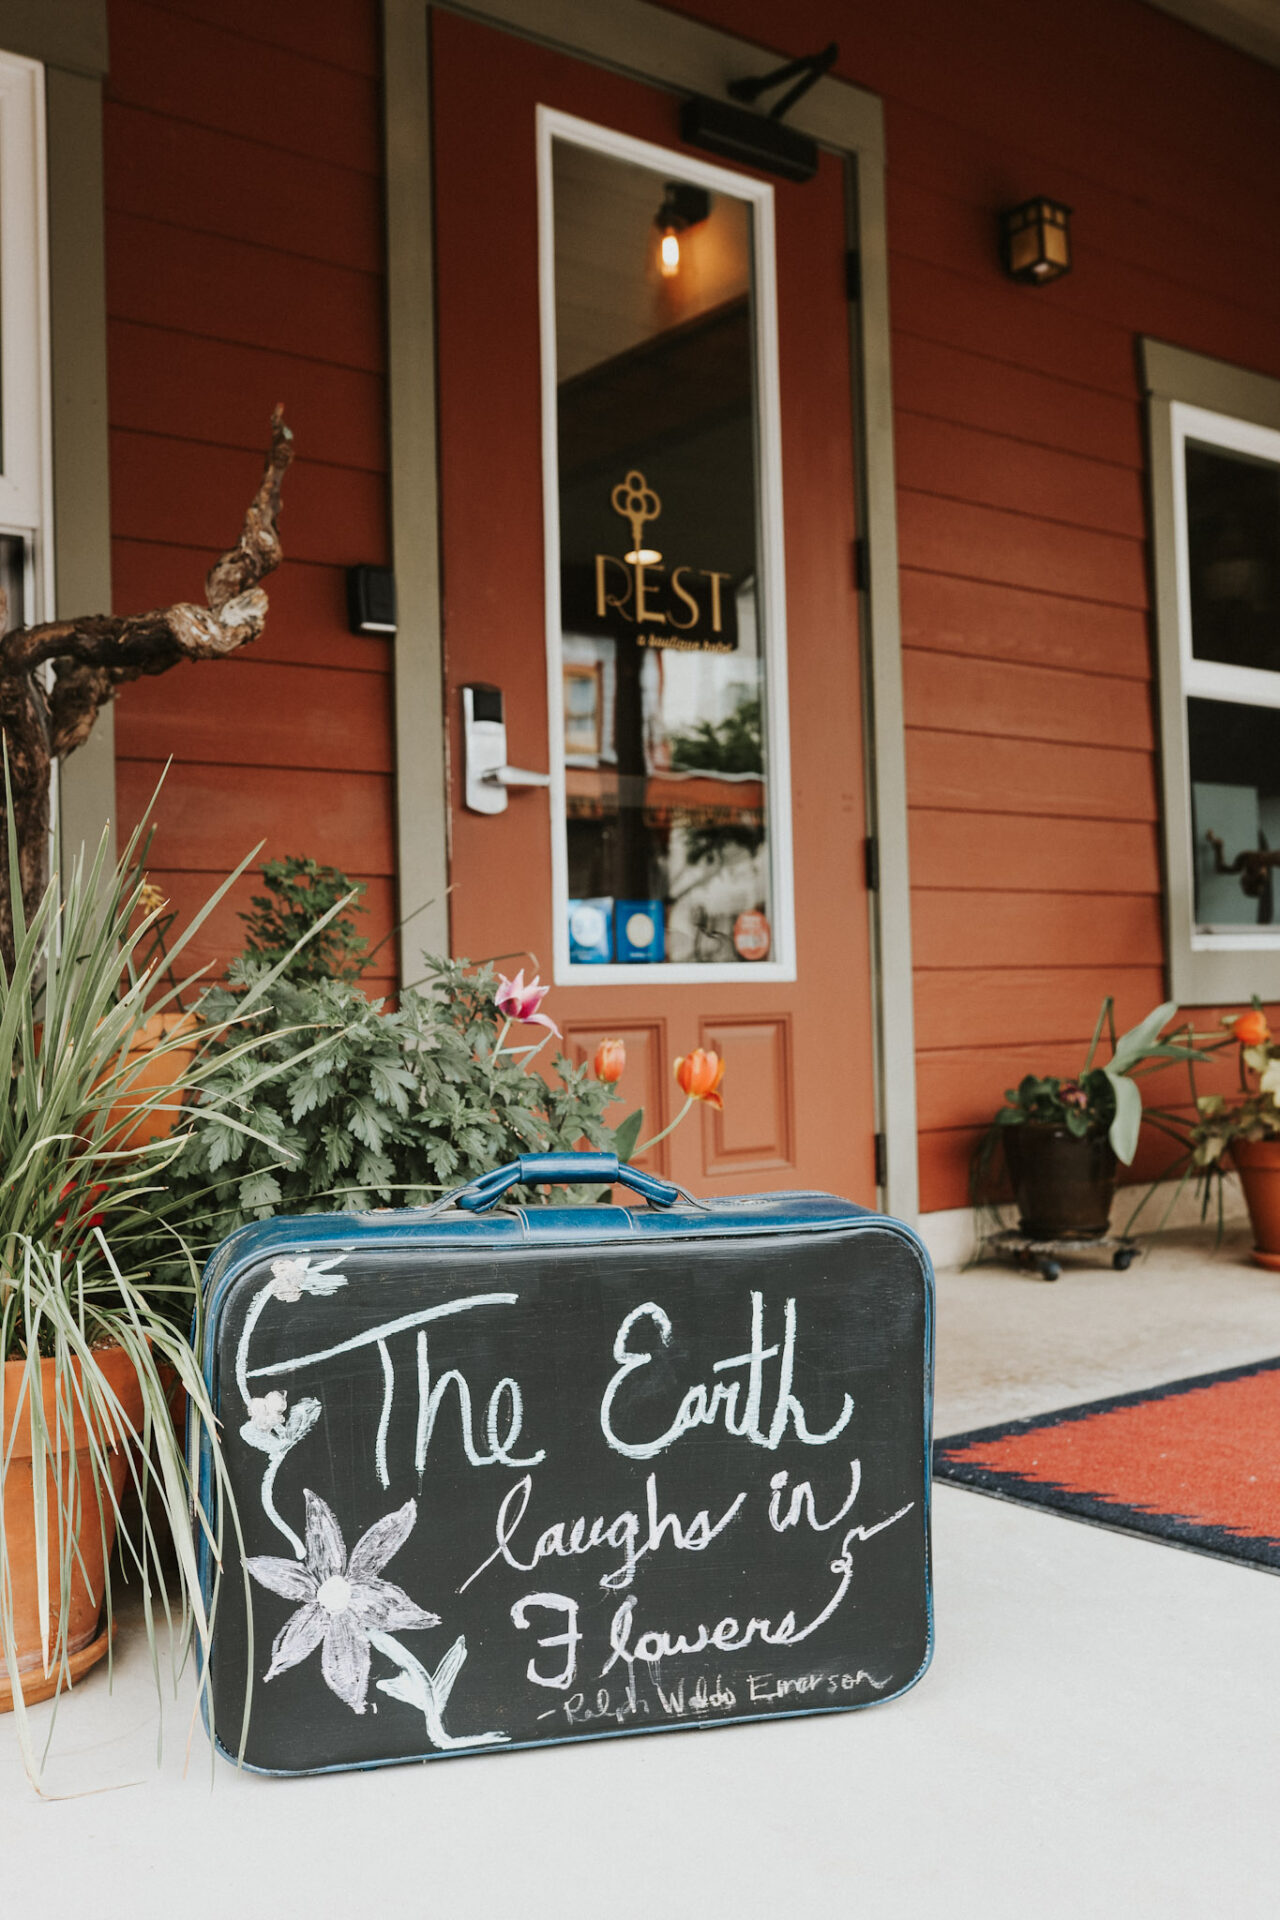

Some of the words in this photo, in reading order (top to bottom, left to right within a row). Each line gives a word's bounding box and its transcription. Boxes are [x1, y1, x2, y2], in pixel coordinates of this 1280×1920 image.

[596, 554, 731, 632] REST
[246, 1292, 547, 1490] The
[600, 1289, 855, 1460] Earth
[459, 1473, 748, 1592] laughs
[768, 1458, 861, 1532] in
